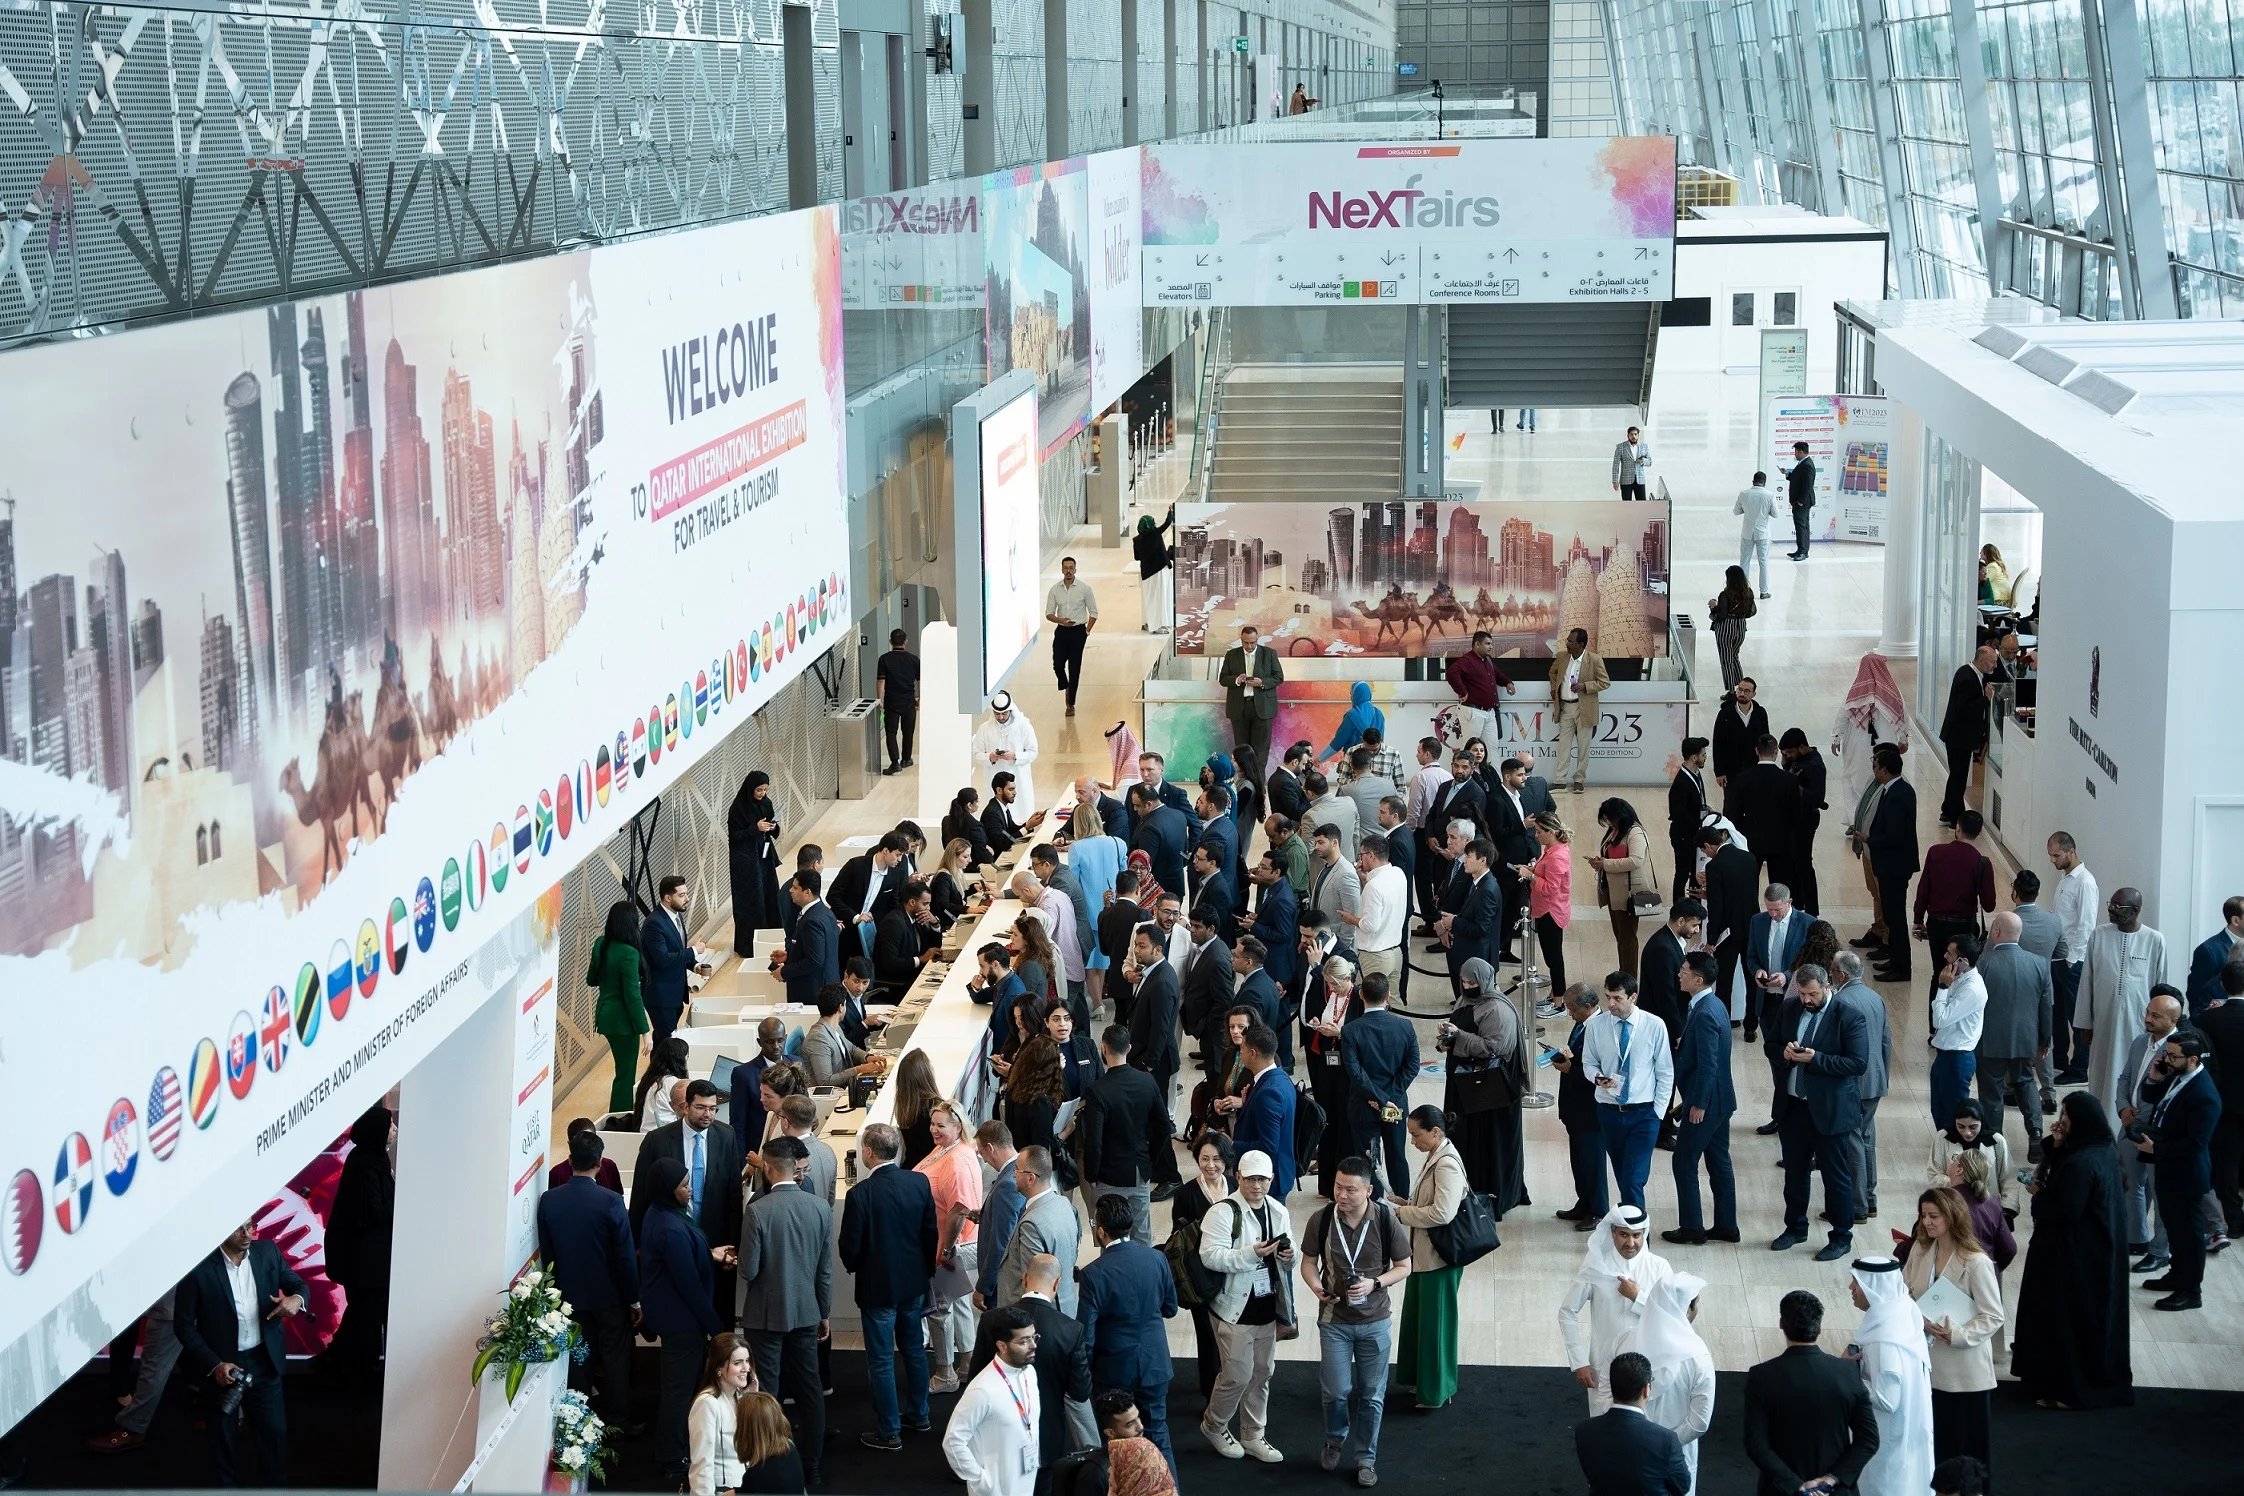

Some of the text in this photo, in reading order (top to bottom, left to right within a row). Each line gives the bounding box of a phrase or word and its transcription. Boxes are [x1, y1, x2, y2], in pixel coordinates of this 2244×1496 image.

[1444, 280, 1500, 288] غرف الاجتماعات
[1595, 278, 1625, 287] المعارض
[1627, 278, 1649, 286] قاعات
[1167, 283, 1193, 291] المصعد
[1569, 287, 1608, 296] Exhibition
[1610, 287, 1629, 295] Halls
[1158, 292, 1193, 300] Elevators
[1315, 291, 1342, 300] Parking
[1429, 289, 1500, 297] Conference Rooms
[662, 312, 779, 426] WELCOME
[631, 405, 806, 521] TO QATAR INTERNATIONAL EXHIBITION
[674, 467, 779, 554] FOR TRAVEL & TOURISM
[2069, 716, 2079, 741] THE
[256, 958, 469, 1157] PRIME MINISTER AND MINISTER OF FOREIGN AFFAIRS
[522, 1124, 541, 1155] QATAR
